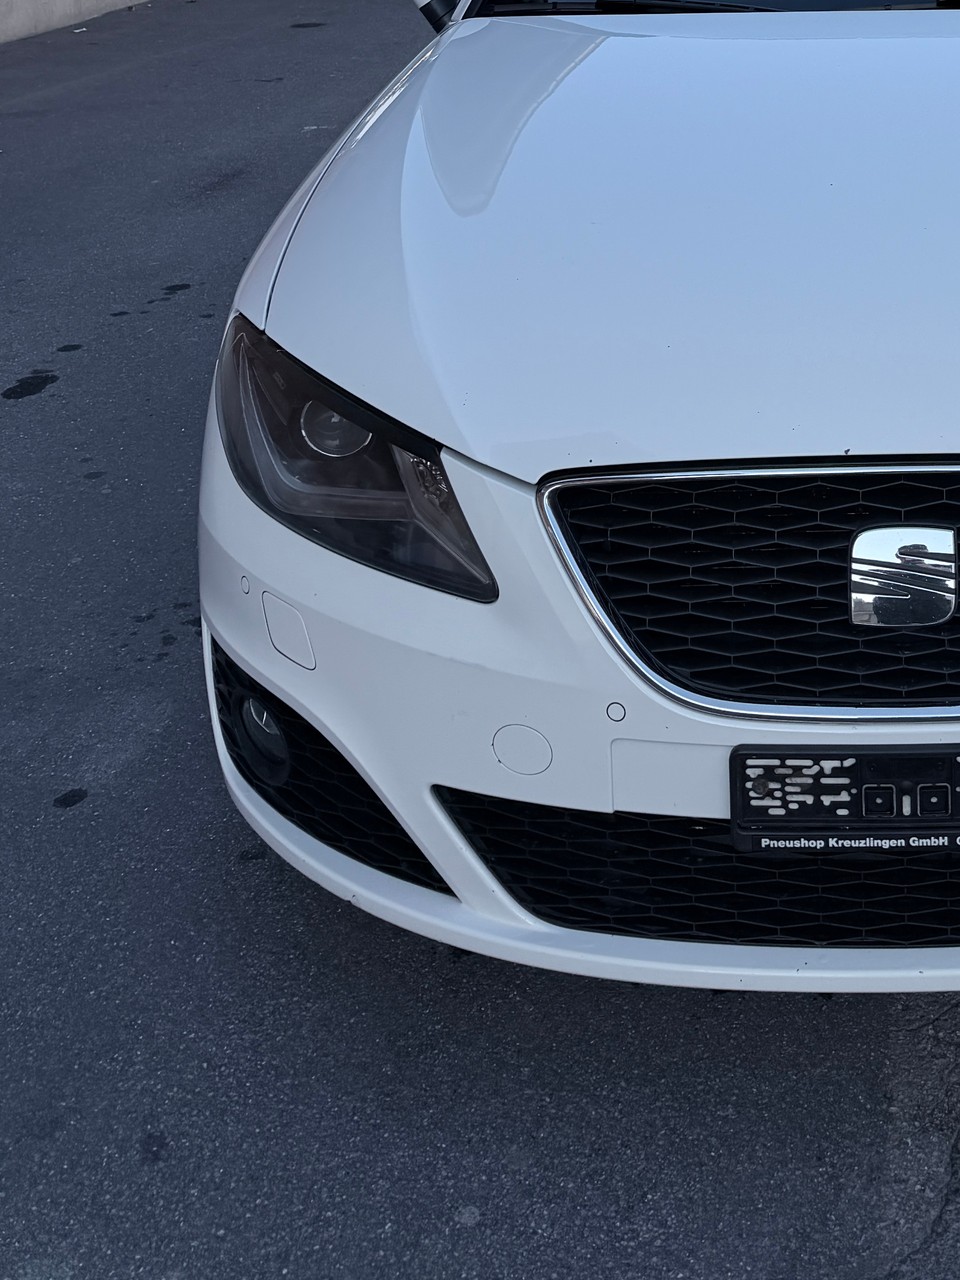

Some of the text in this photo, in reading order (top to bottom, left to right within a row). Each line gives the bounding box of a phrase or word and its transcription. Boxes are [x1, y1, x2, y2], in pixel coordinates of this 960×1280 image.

[761, 837, 825, 850] Pneushop
[828, 837, 906, 849] Kreuzlingen
[909, 836, 949, 847] GmbH
